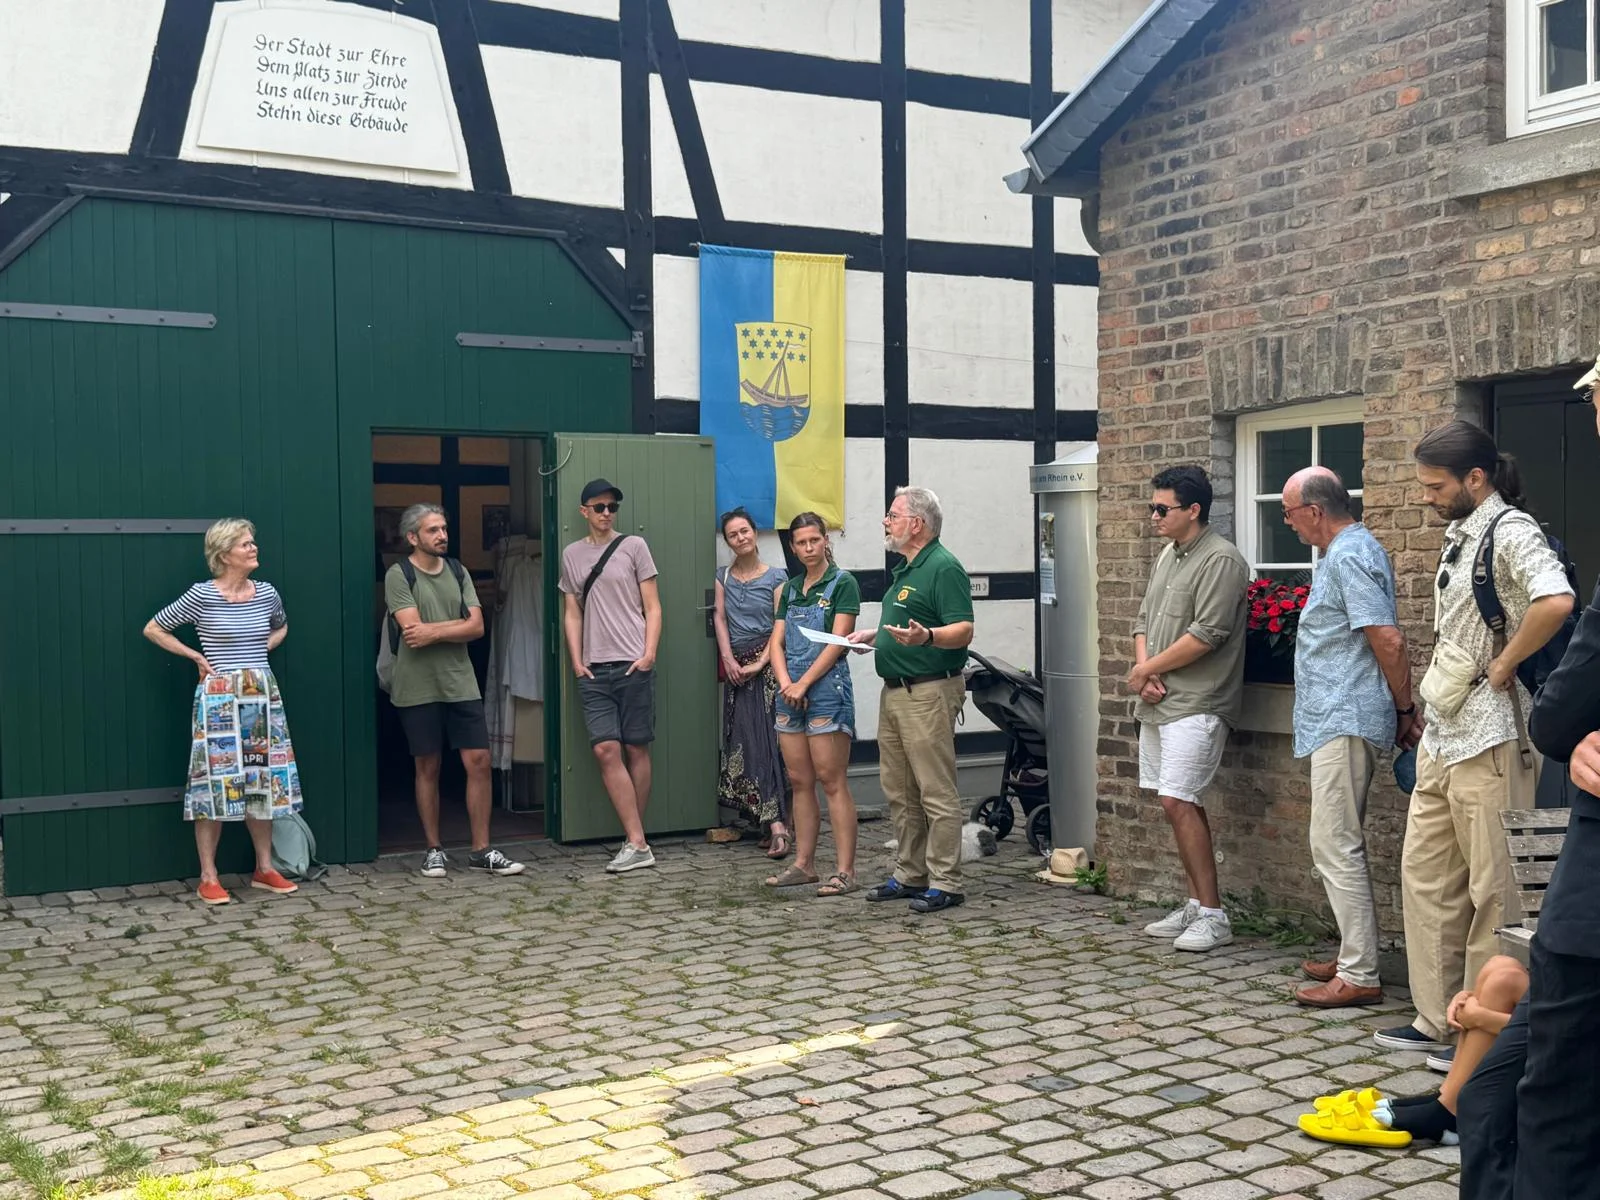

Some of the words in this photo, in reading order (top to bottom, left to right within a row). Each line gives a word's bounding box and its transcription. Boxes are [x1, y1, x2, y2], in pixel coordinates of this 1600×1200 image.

[254, 34, 284, 51] Der
[286, 37, 332, 58] Stadt
[337, 48, 364, 62] zur
[369, 48, 407, 67] Ehre
[256, 55, 290, 75] Dem
[293, 61, 330, 82] Platz
[334, 70, 360, 84] zur
[363, 69, 408, 90] Zierde
[256, 78, 287, 98] Uns
[293, 85, 329, 102] allen
[332, 93, 359, 106] zur
[359, 91, 408, 112] Freude
[307, 107, 342, 126] diese
[350, 112, 408, 133] Gebäude
[1048, 473, 1067, 481] Rhein
[1070, 472, 1085, 481] e.V.
